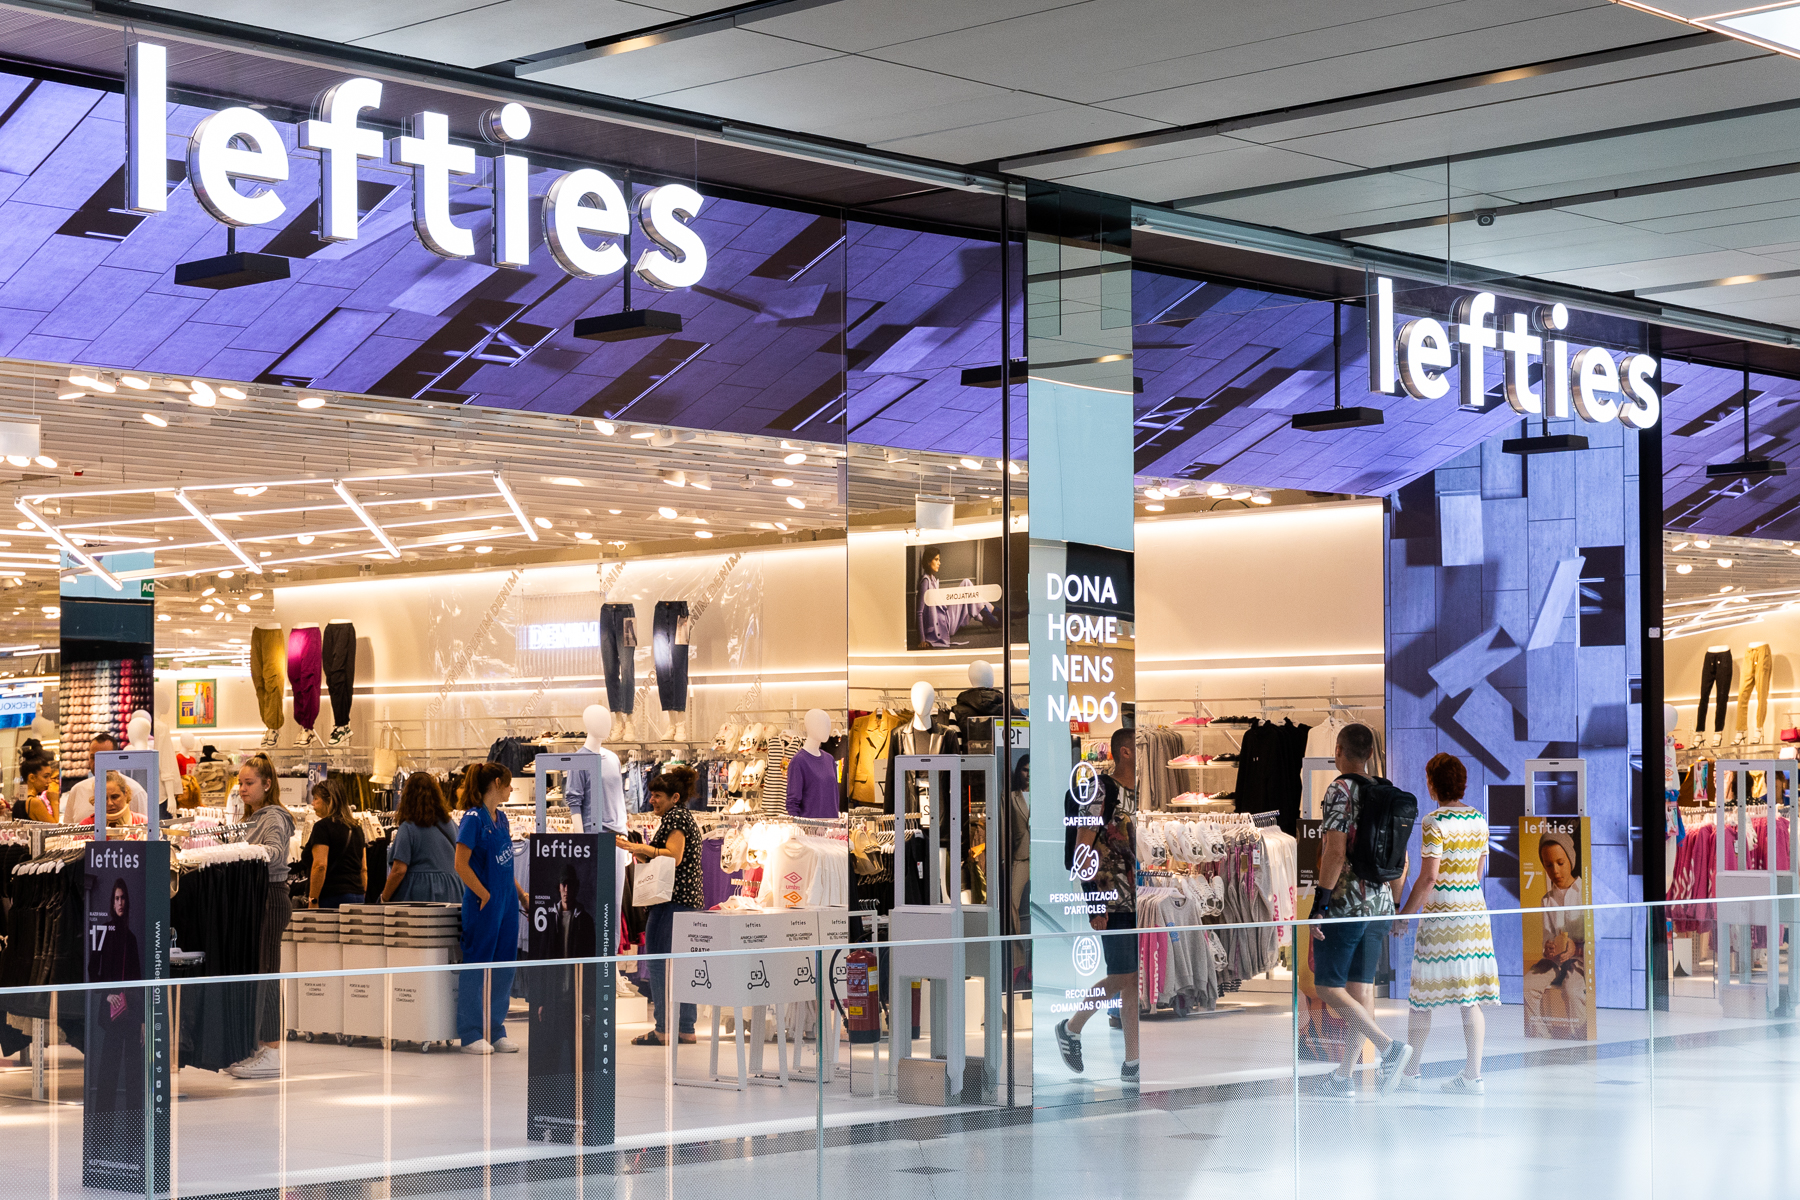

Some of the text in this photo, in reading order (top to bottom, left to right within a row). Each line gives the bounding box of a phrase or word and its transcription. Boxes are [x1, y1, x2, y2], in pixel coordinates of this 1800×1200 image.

[128, 42, 707, 290] lefties
[1370, 277, 1660, 429] lefties
[490, 571, 519, 616] DENIM
[1047, 573, 1118, 604] DONA
[1048, 613, 1118, 644] HOME
[1052, 654, 1114, 683] NENS
[1047, 691, 1118, 724] NADÓ
[1063, 816, 1104, 826] CAFETERIA
[1525, 821, 1574, 834] lefties
[91, 848, 140, 868] lefties
[536, 839, 591, 858] lefties
[1300, 880, 1312, 899] 7
[1523, 871, 1535, 889] 7
[1050, 889, 1118, 903] PERSONALITZACIÓ
[534, 907, 547, 932] 6
[1064, 904, 1106, 915] D'ARTICLES
[89, 925, 107, 951] 17
[1065, 987, 1106, 999] RECOLLIDA
[1051, 998, 1123, 1013] COMANDAS ONLINE
